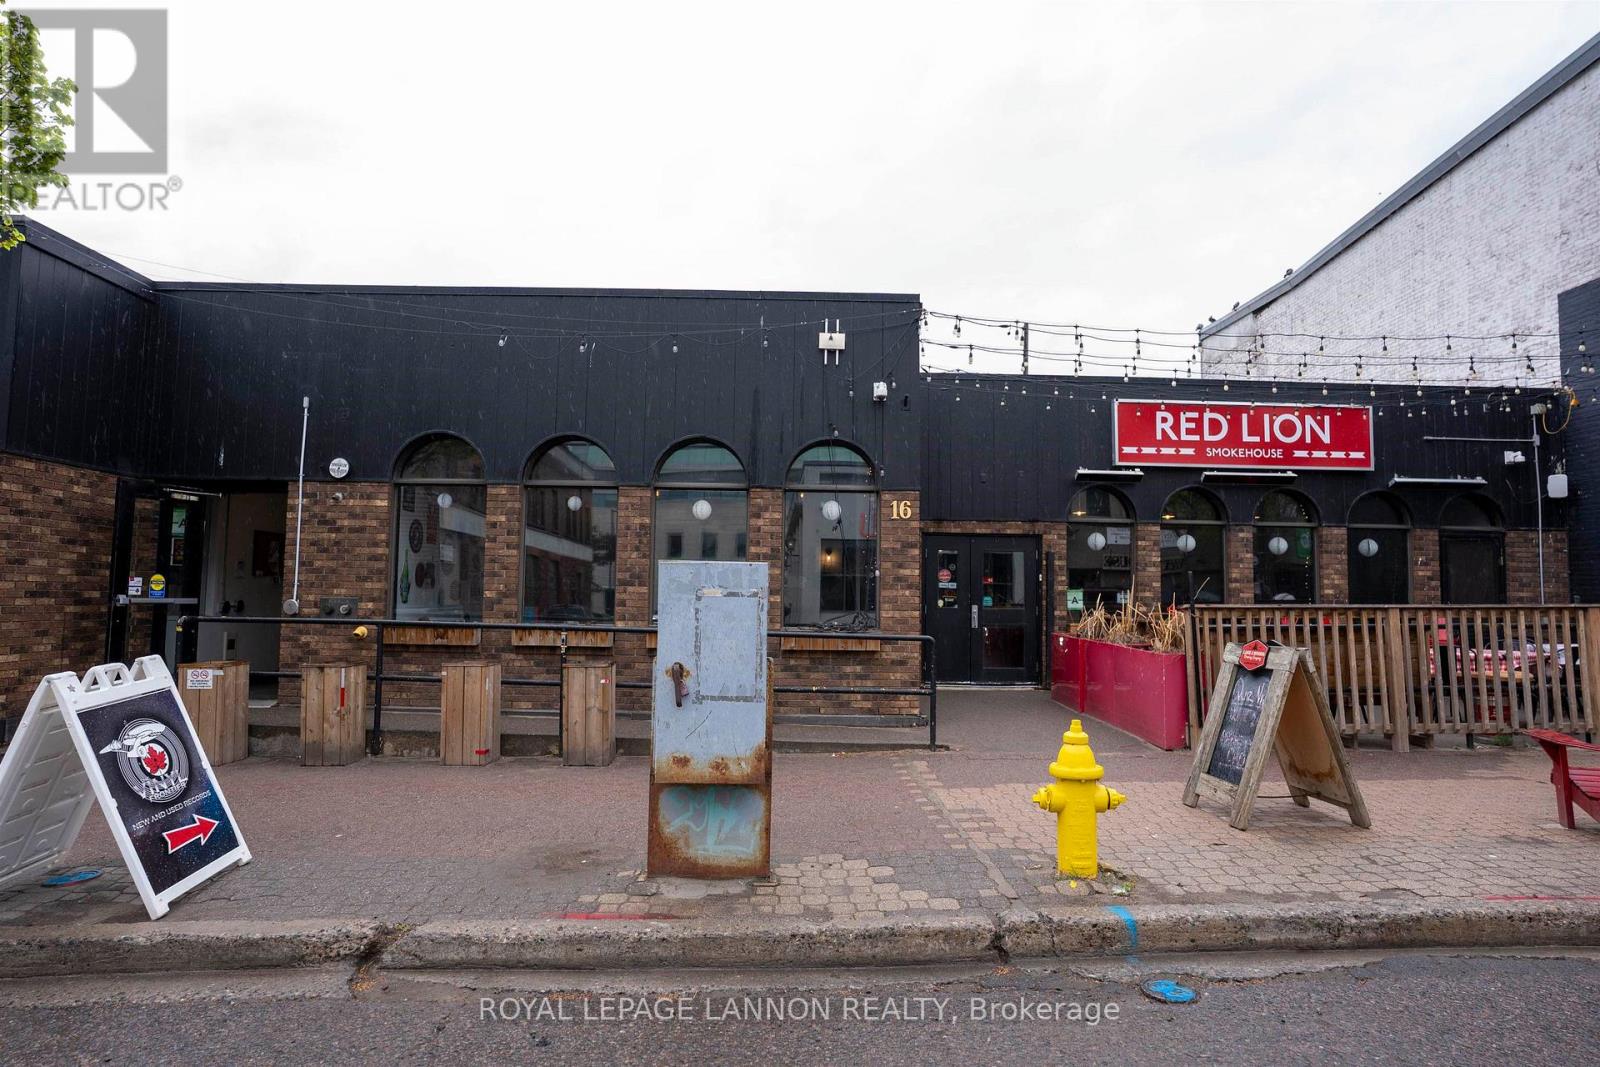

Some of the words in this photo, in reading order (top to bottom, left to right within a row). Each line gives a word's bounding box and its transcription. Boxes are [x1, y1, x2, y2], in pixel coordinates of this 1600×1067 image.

[1155, 411, 1229, 442] RED
[1242, 413, 1331, 444] LION
[1206, 447, 1284, 459] SMOKEHOUSE
[890, 500, 912, 519] 16
[132, 817, 151, 831] NEW
[151, 810, 166, 823] AND
[166, 803, 183, 815] USED
[183, 789, 211, 808] RECORDS
